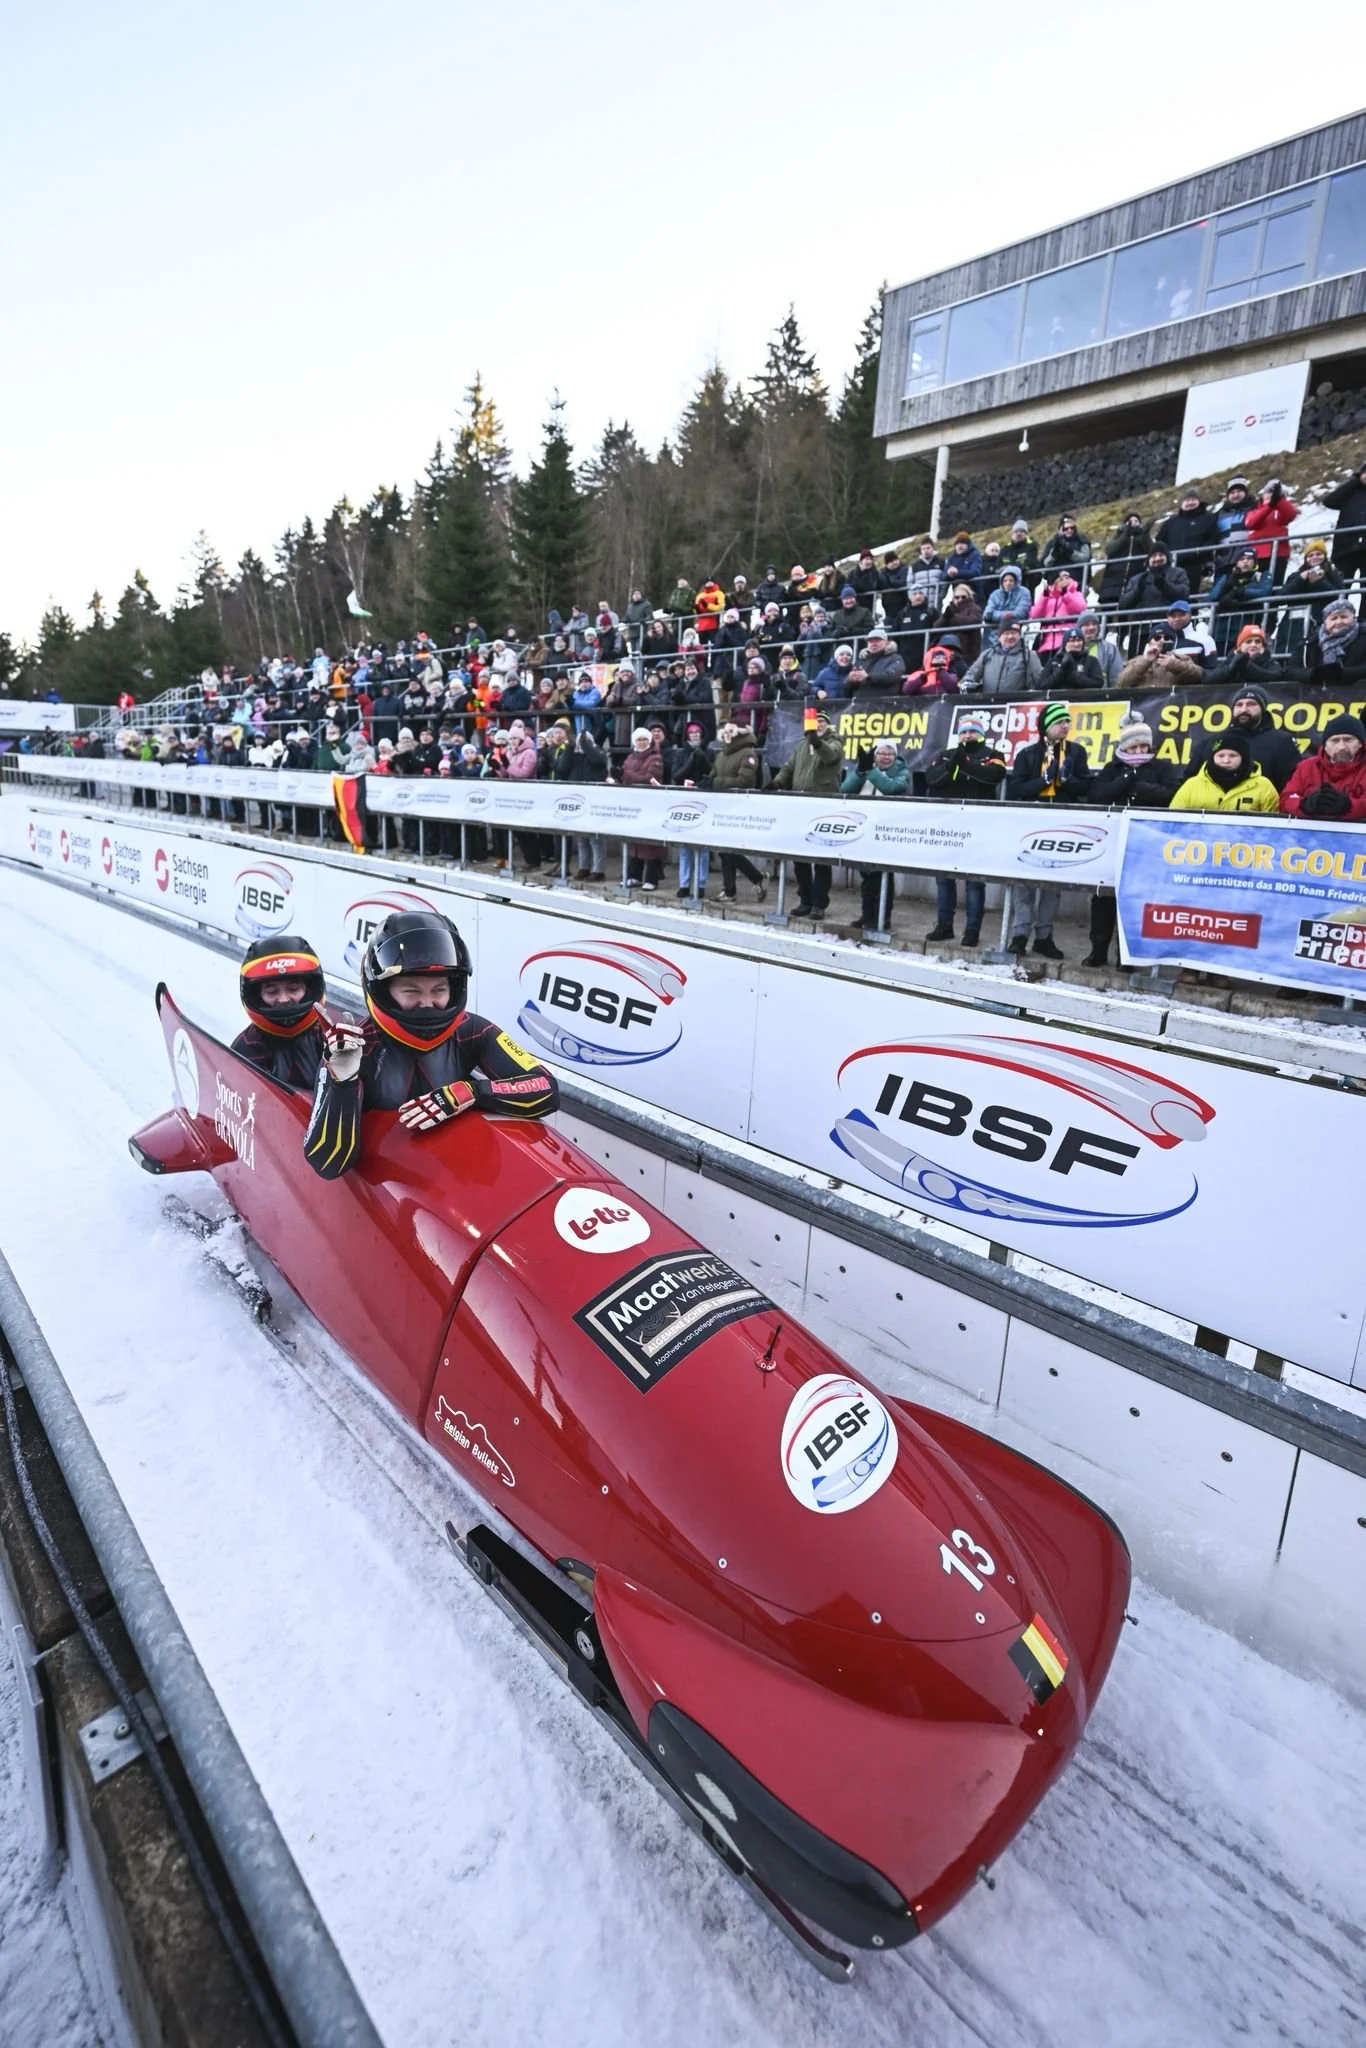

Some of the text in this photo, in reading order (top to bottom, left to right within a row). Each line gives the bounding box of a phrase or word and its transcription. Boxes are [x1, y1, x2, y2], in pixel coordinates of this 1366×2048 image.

[839, 712, 929, 736] REGION
[904, 737, 923, 749] AN
[558, 803, 582, 812] IBSF
[670, 812, 701, 822] IBSF
[814, 822, 857, 835] IBSF
[875, 824, 972, 840] International Bobsleigh
[882, 834, 918, 845] Skeleton
[919, 837, 964, 848] Federation
[1031, 838, 1095, 854] IBSF
[1163, 839, 1208, 867] GO
[1213, 841, 1276, 871] FOR
[172, 853, 208, 880] Sachsen
[173, 877, 207, 905] Energie
[1173, 873, 1191, 884] Wir
[1193, 876, 1254, 889] unterstützen
[1256, 881, 1273, 890] das
[1275, 882, 1297, 893] BOB
[1299, 885, 1325, 897] Team
[242, 885, 285, 913] IBSF
[1152, 909, 1249, 932] WEMPE
[1173, 926, 1224, 941] Dresden
[266, 958, 296, 970] LAZER
[538, 973, 657, 1030] IBSF
[503, 1038, 524, 1057] SPORT
[216, 1071, 242, 1117] Sports
[491, 1077, 551, 1095] BELGIUM
[875, 1073, 1141, 1176] IBSF
[214, 1107, 255, 1171] GRANOLA
[568, 1207, 631, 1240] Lotto
[607, 1262, 725, 1332] Maatwerk
[676, 1286, 701, 1303] Van
[647, 1320, 686, 1354] ALGEMENE
[443, 1418, 470, 1449] Belgian
[803, 1401, 871, 1470] IBSF
[471, 1443, 499, 1475] Bullets
[939, 1529, 995, 1592] 13
